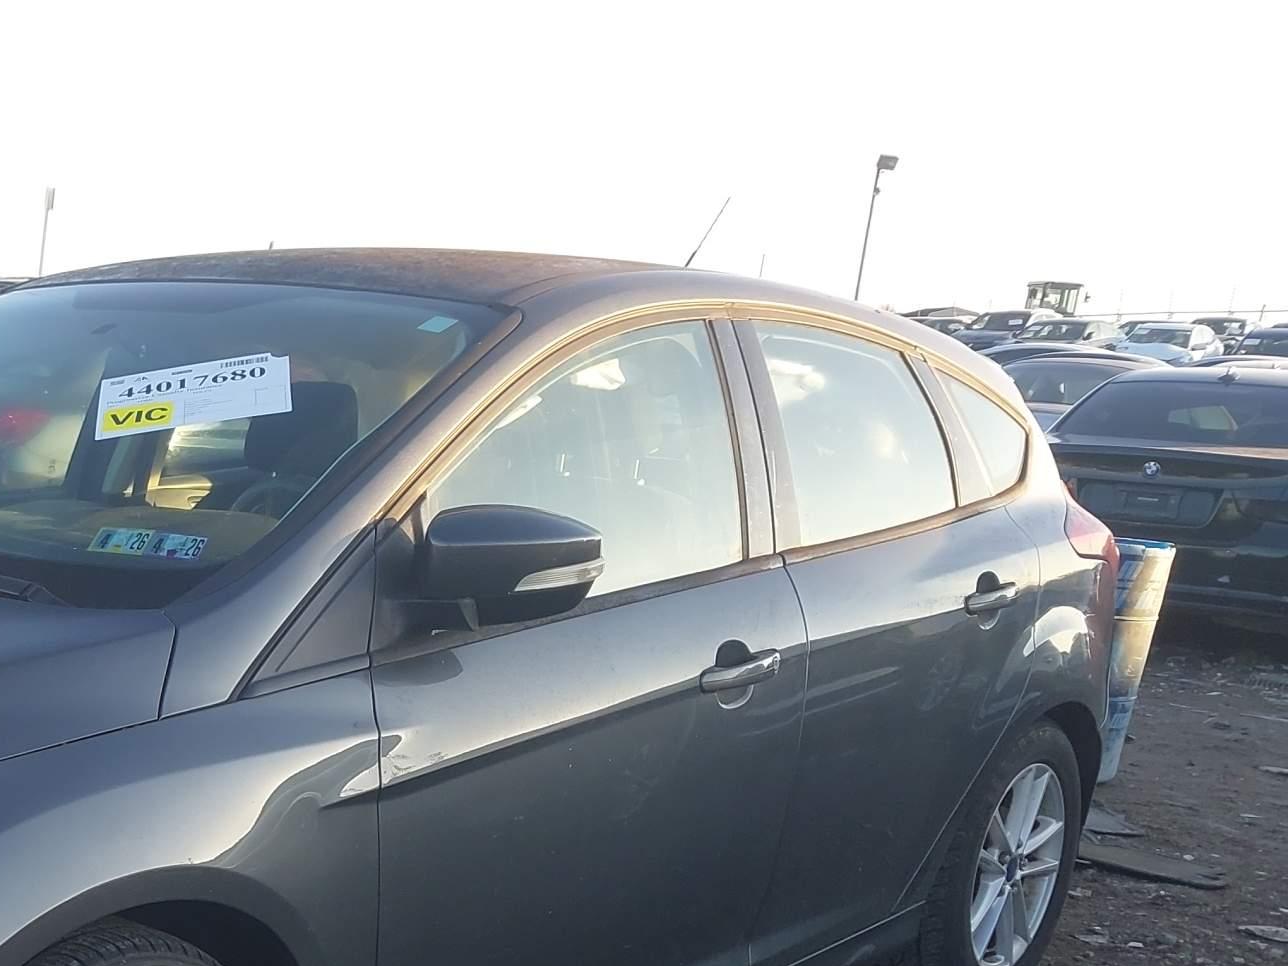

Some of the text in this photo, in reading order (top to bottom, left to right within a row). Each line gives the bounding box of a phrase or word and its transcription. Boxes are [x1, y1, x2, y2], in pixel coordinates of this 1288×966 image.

[118, 366, 267, 398] 44017680
[109, 407, 169, 426] VIC
[129, 532, 149, 550] 26
[184, 538, 205, 557] 26
